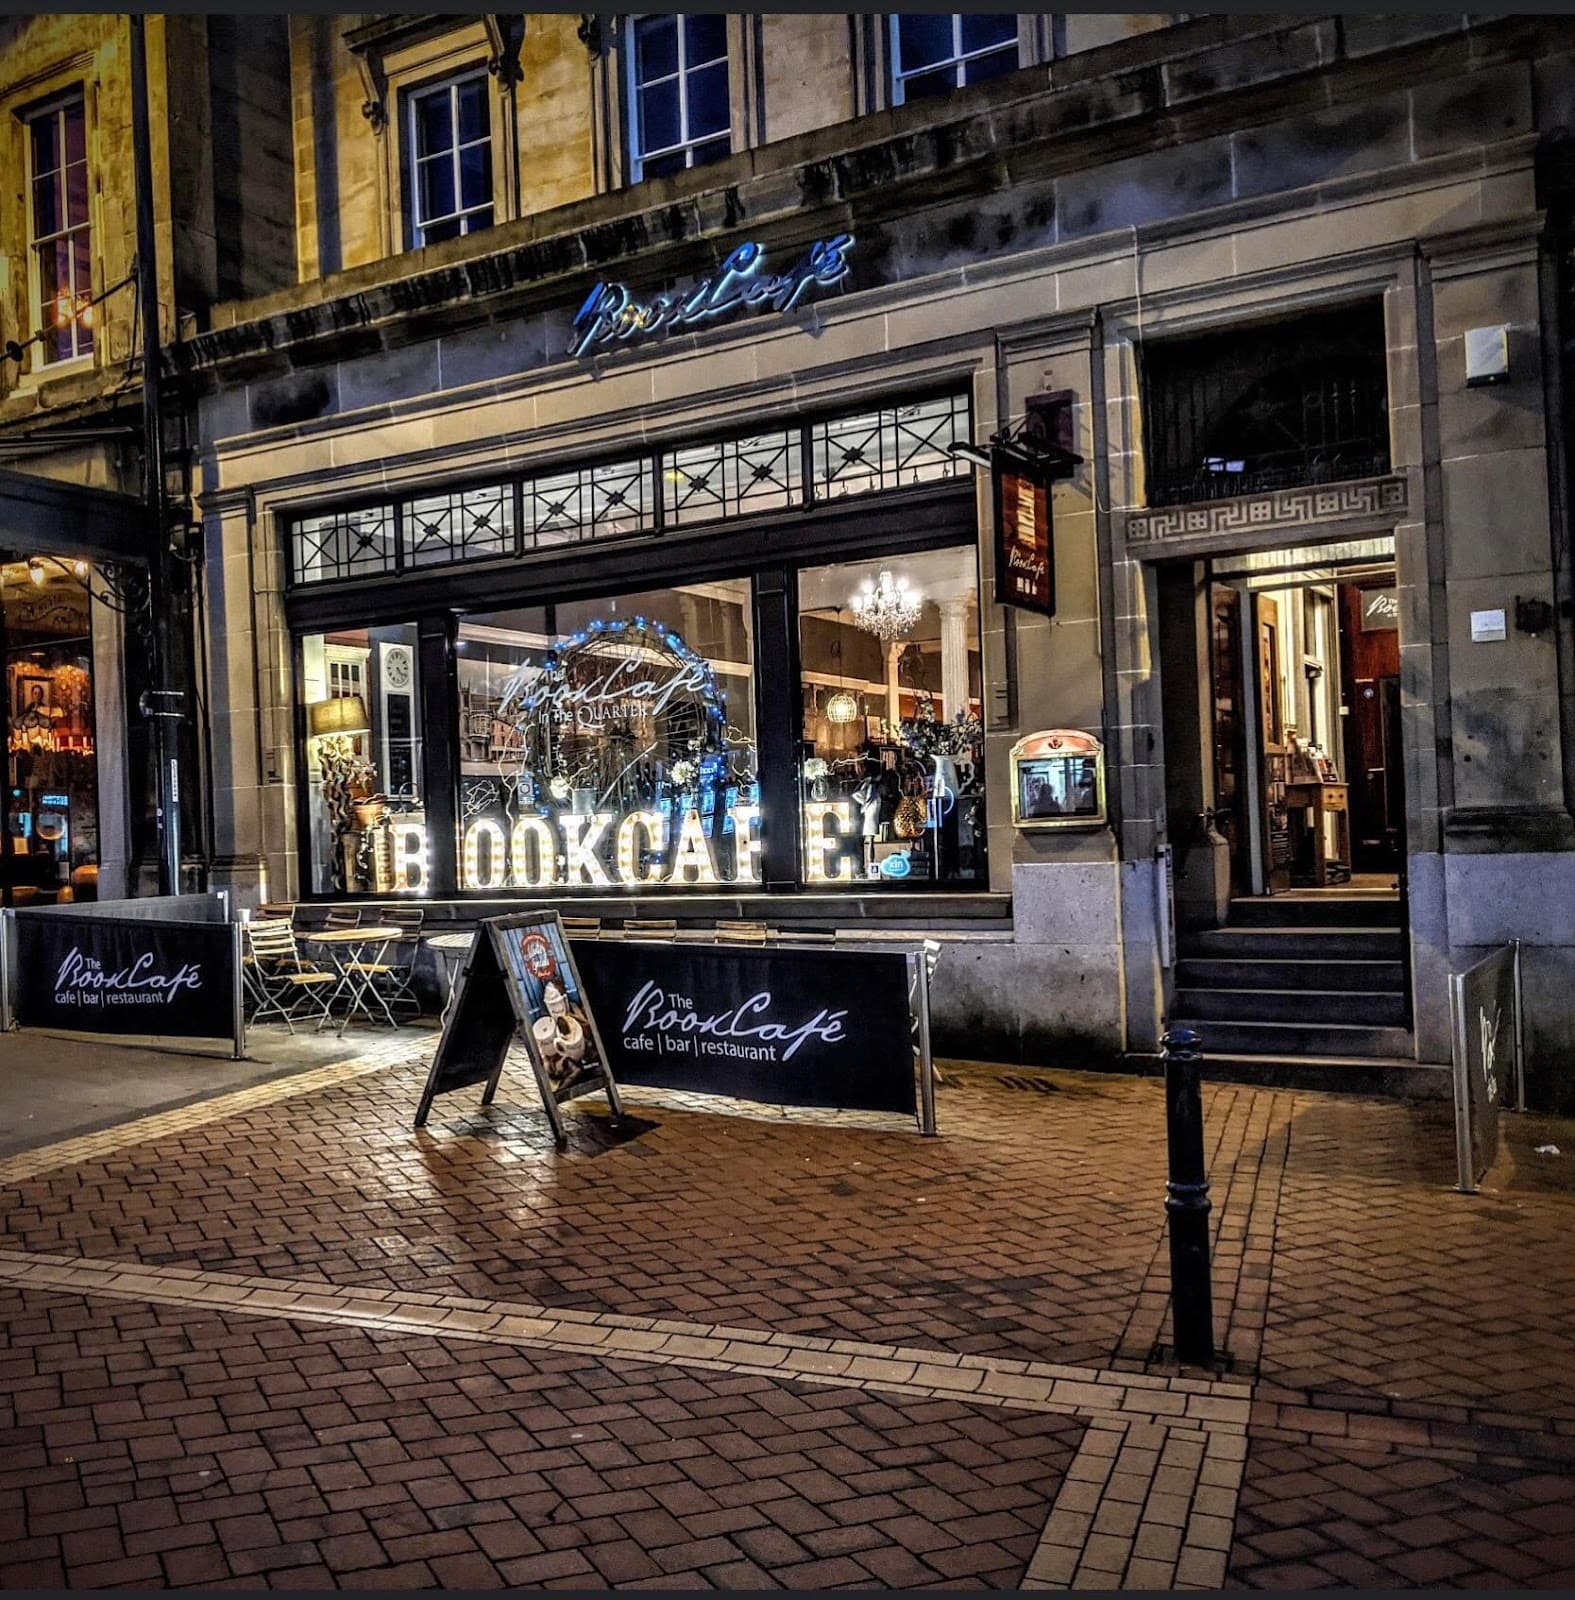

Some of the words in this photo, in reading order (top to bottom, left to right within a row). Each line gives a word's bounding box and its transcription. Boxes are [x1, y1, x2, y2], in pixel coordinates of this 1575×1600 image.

[538, 710, 550, 724] In
[552, 708, 574, 723] The
[85, 958, 101, 970] The
[55, 991, 76, 1004] cafe
[83, 990, 99, 1005] bar
[106, 991, 164, 1005] restaurant
[667, 993, 693, 1010] The
[623, 1033, 654, 1051] cafe
[665, 1034, 691, 1053] bar
[701, 1038, 777, 1062] restaurant
